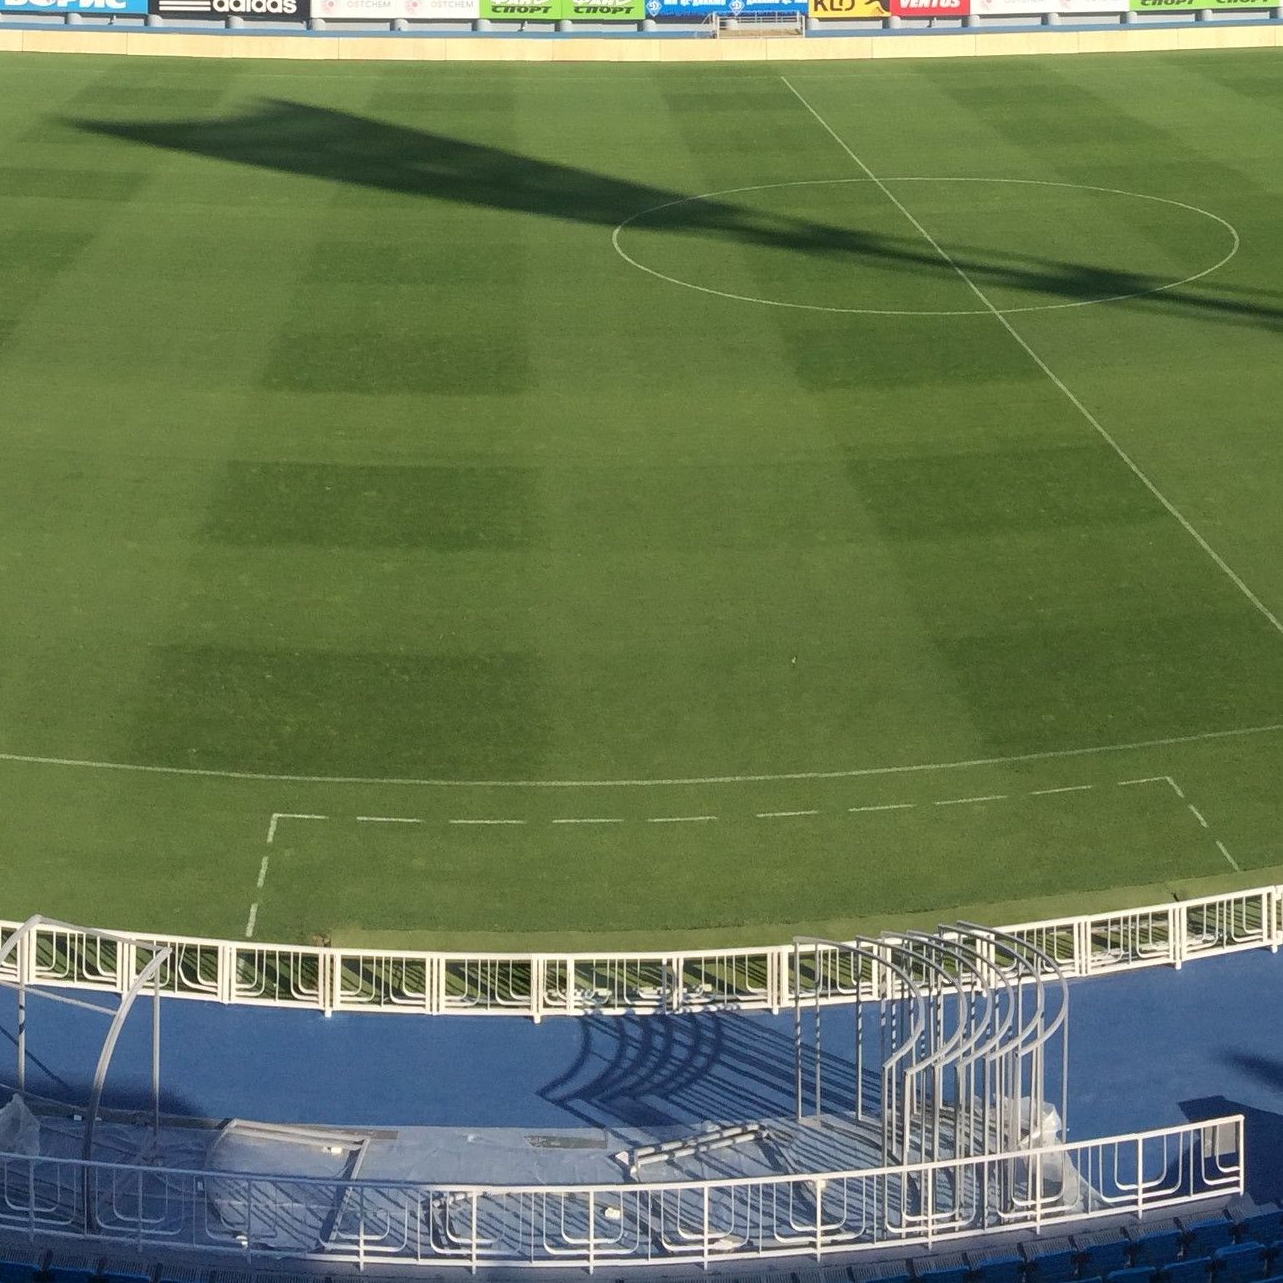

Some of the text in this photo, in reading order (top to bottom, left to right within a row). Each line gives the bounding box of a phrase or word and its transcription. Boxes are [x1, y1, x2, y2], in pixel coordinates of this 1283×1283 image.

[347, 0, 390, 8] OSTCHEM
[430, 0, 473, 8] OSTCHEM
[491, 6, 551, 14] СПОРТ
[574, 6, 634, 14] СПОРТ
